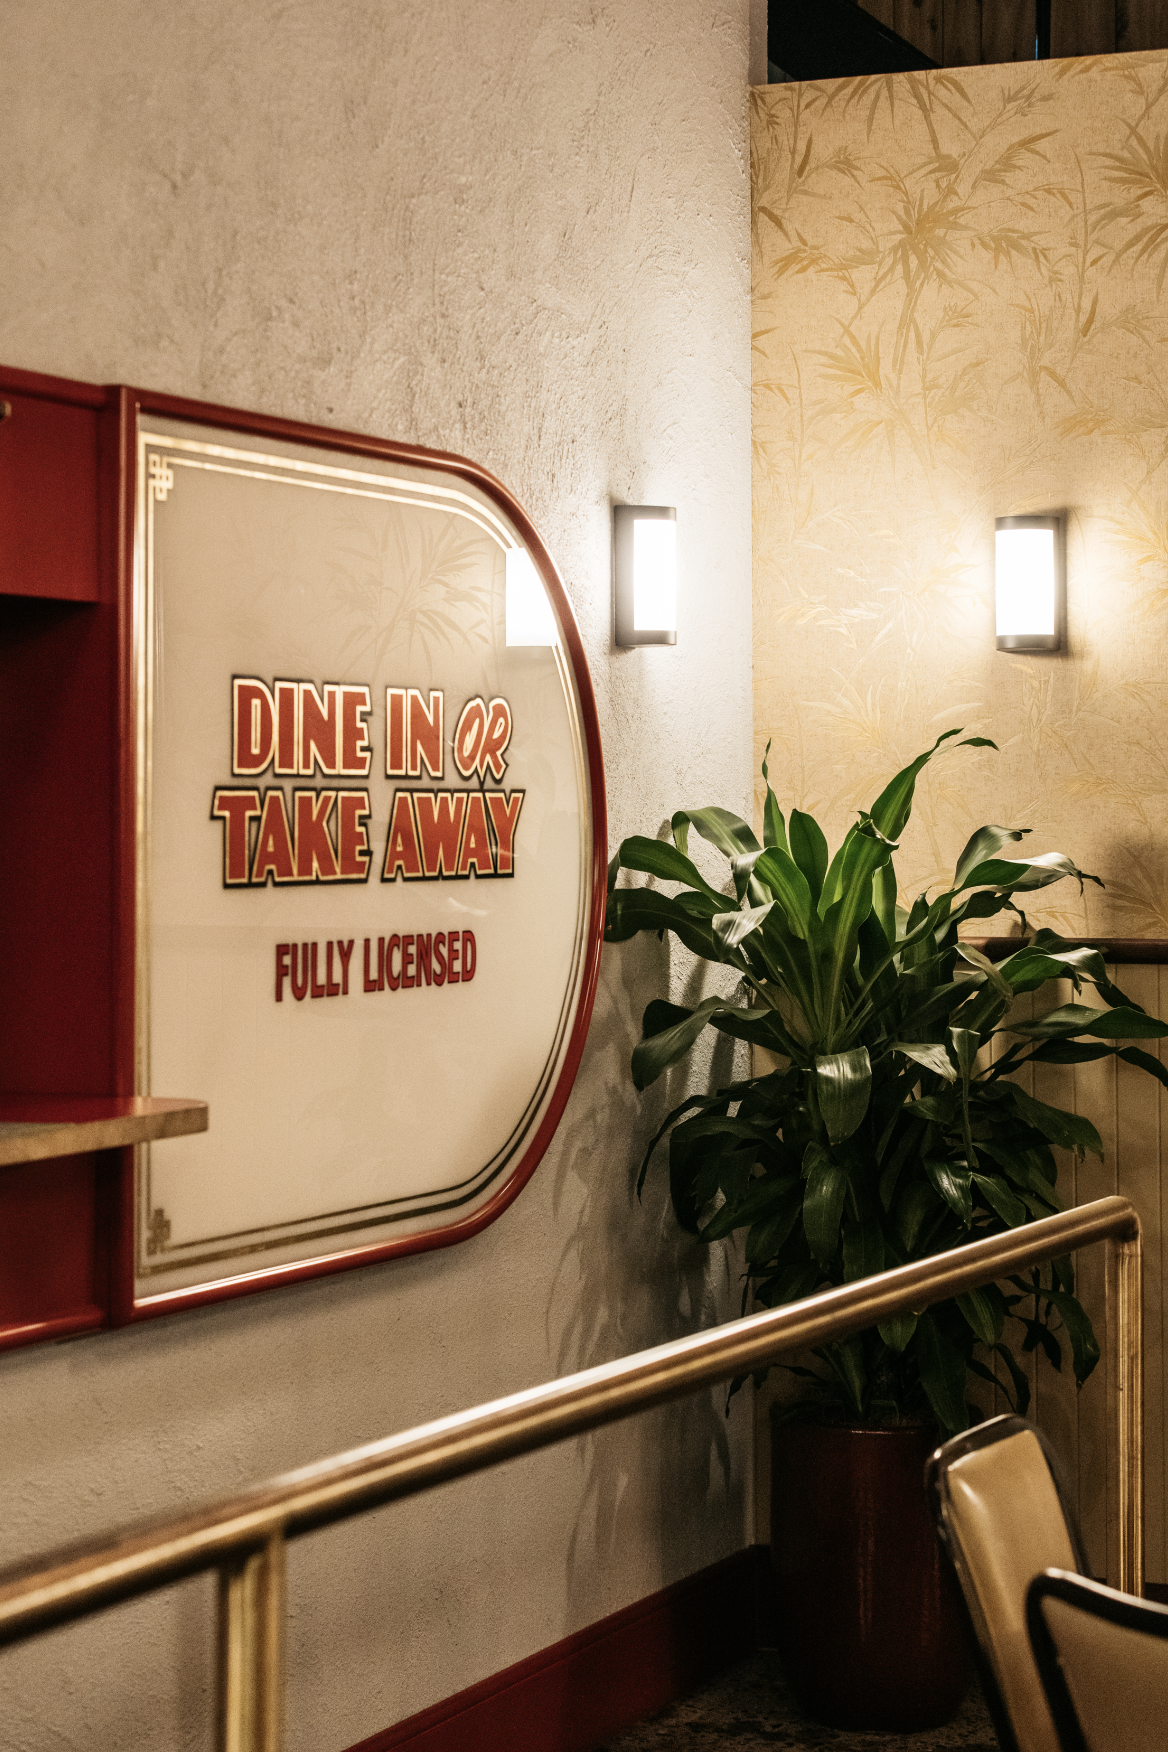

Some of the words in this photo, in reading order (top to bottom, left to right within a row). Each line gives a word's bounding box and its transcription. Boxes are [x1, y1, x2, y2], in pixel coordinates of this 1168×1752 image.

[231, 674, 373, 779] DINE
[385, 686, 445, 780] IN
[453, 694, 513, 785] OR
[210, 786, 373, 888] TAKE
[381, 788, 526, 883] AWAY
[274, 939, 355, 1003] FULLY
[363, 929, 478, 993] LICENSED
